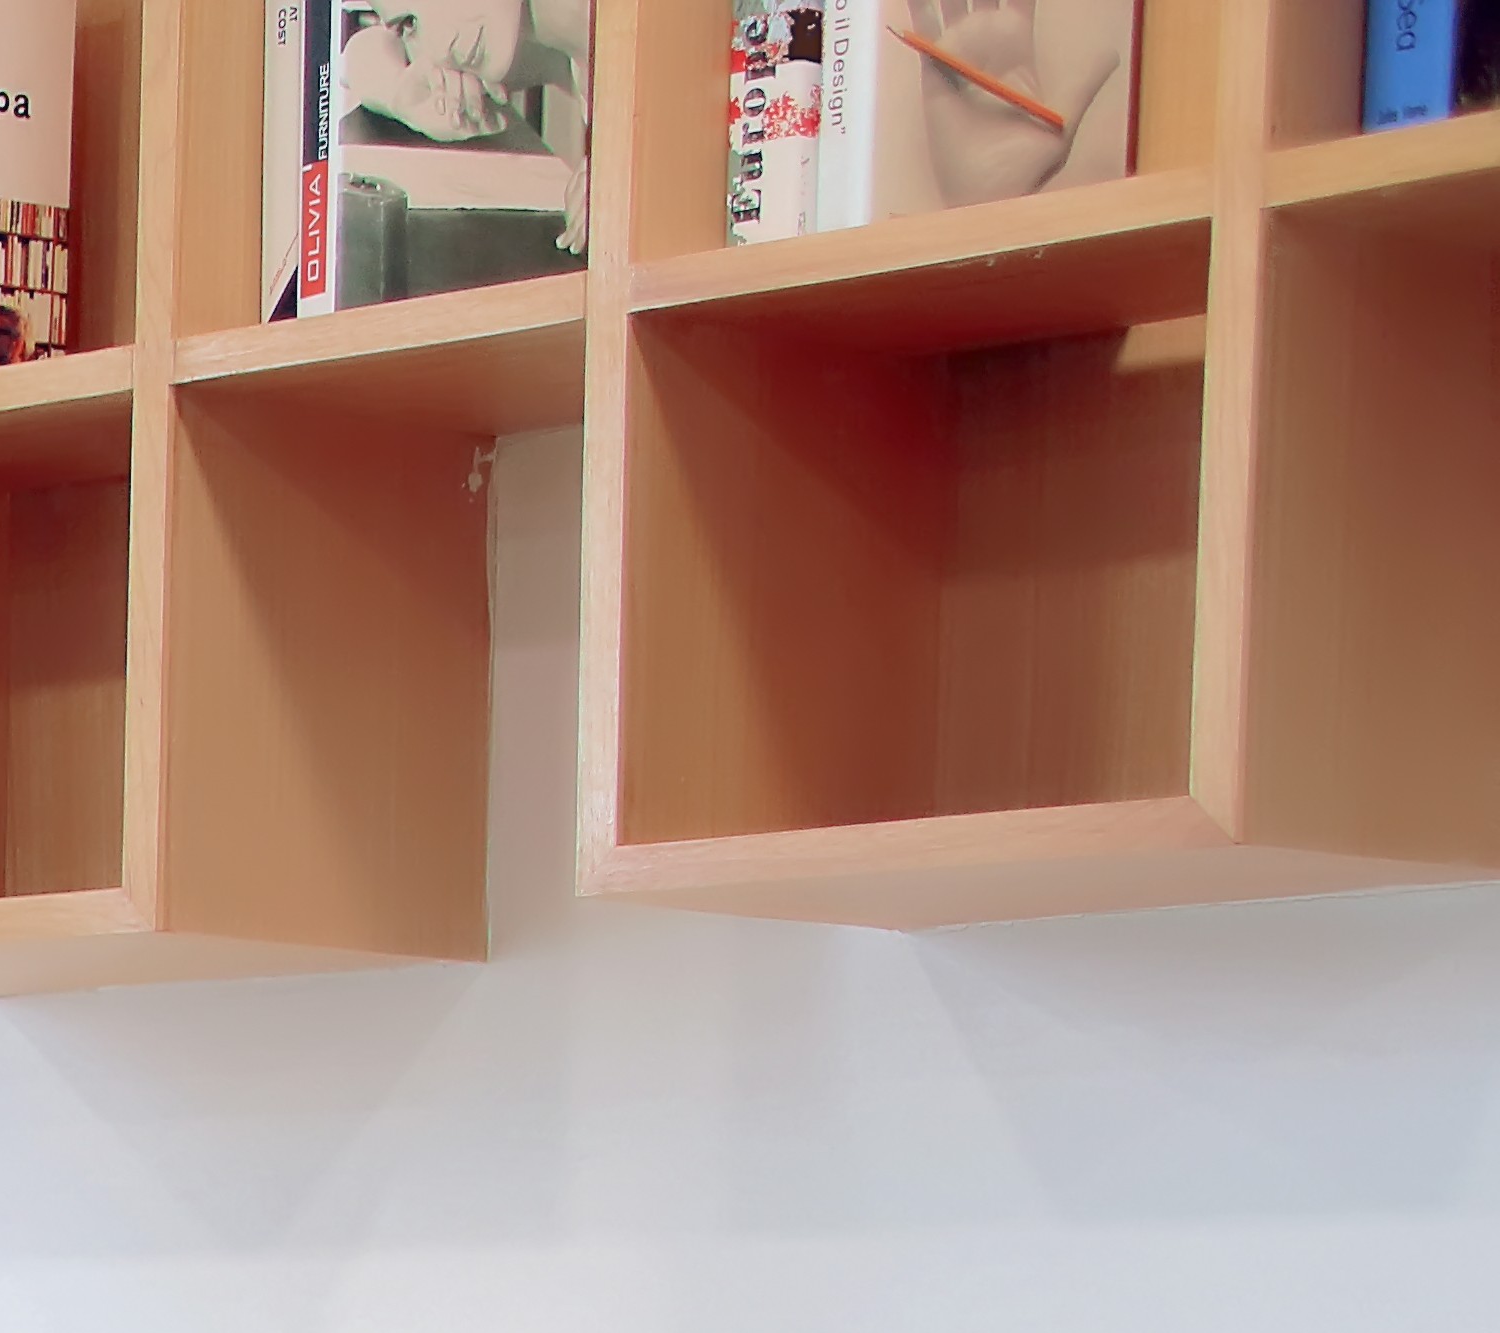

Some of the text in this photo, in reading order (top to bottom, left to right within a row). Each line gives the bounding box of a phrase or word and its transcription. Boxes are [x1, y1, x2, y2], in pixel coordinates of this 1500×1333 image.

[278, 9, 287, 45] COST
[289, 7, 298, 22] AT
[317, 62, 330, 160] FURNITURE
[730, 16, 776, 224] Europe
[306, 173, 322, 282] OLIVIA
